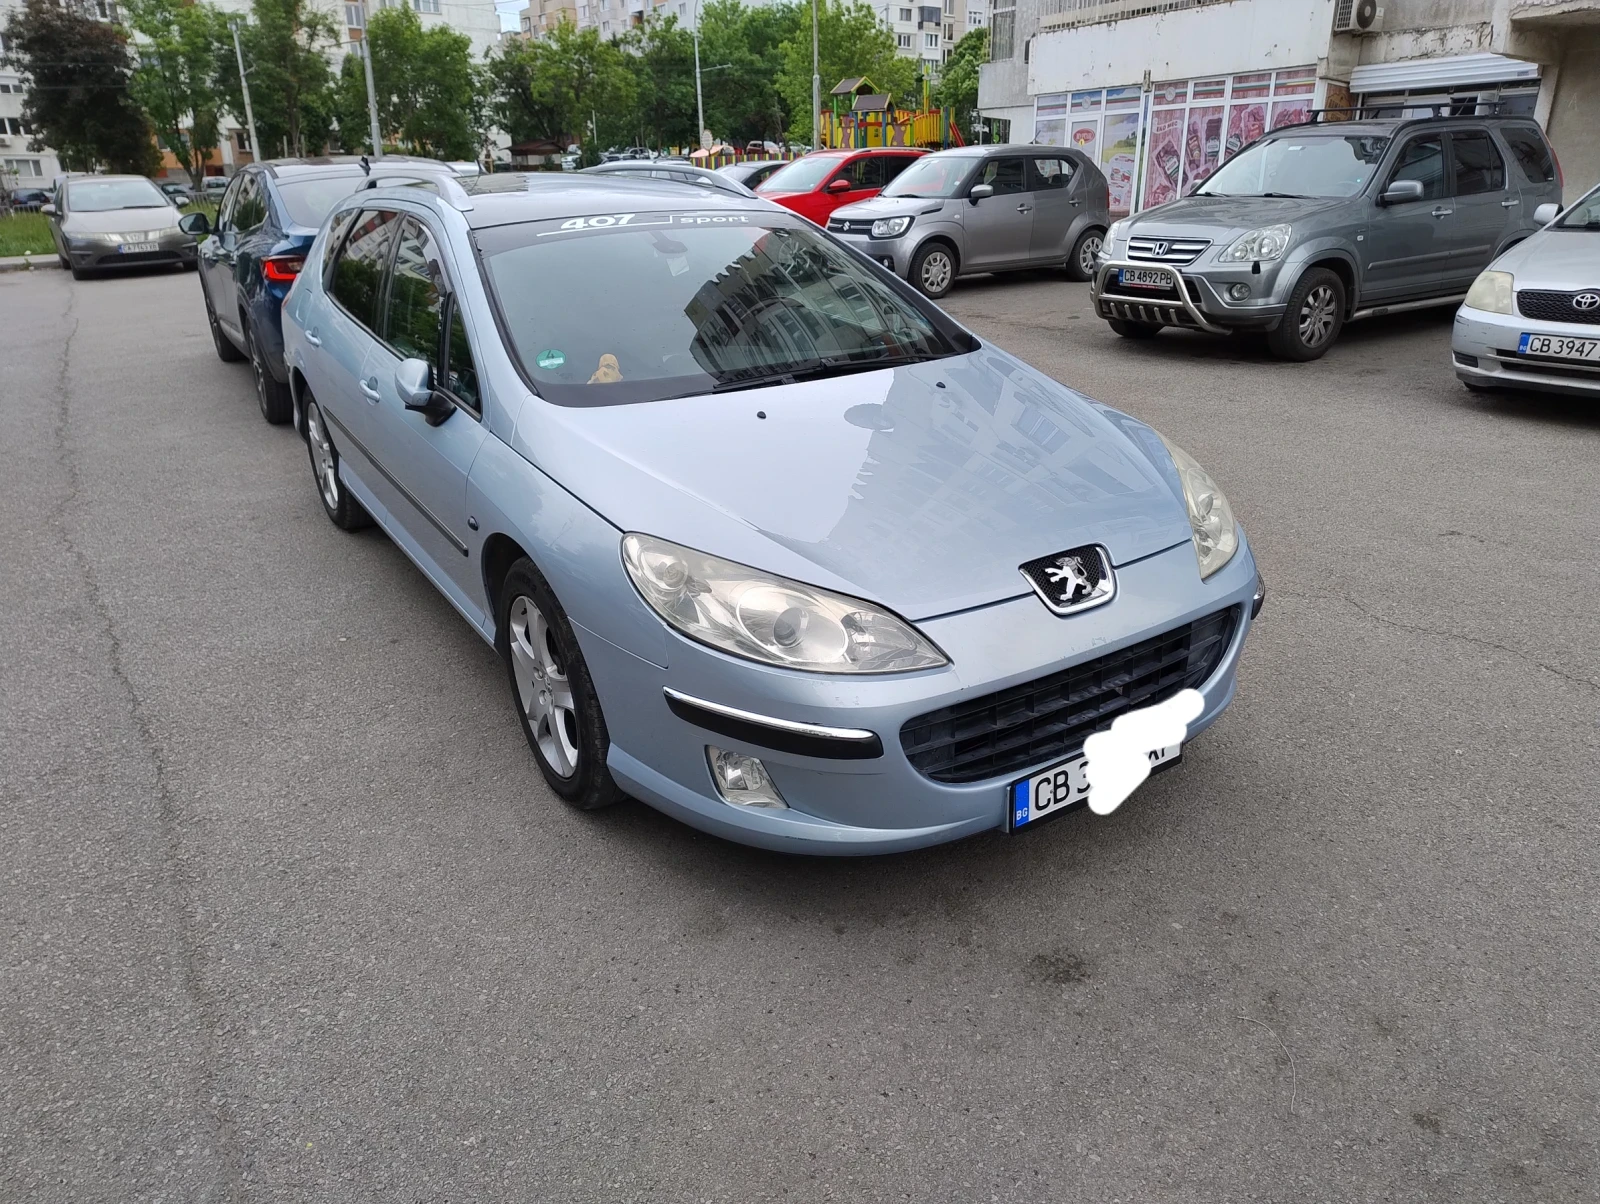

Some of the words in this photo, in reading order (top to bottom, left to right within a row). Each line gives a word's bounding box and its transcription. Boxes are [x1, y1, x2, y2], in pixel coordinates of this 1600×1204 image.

[560, 214, 635, 230] 407
[680, 214, 748, 224] sport
[1124, 270, 1136, 281] CB
[1137, 271, 1159, 284] 4892
[1160, 272, 1172, 285] PB
[1529, 337, 1551, 353] CB
[1553, 339, 1598, 357] 3947
[1034, 769, 1070, 811] CB
[1016, 807, 1028, 821] BG
